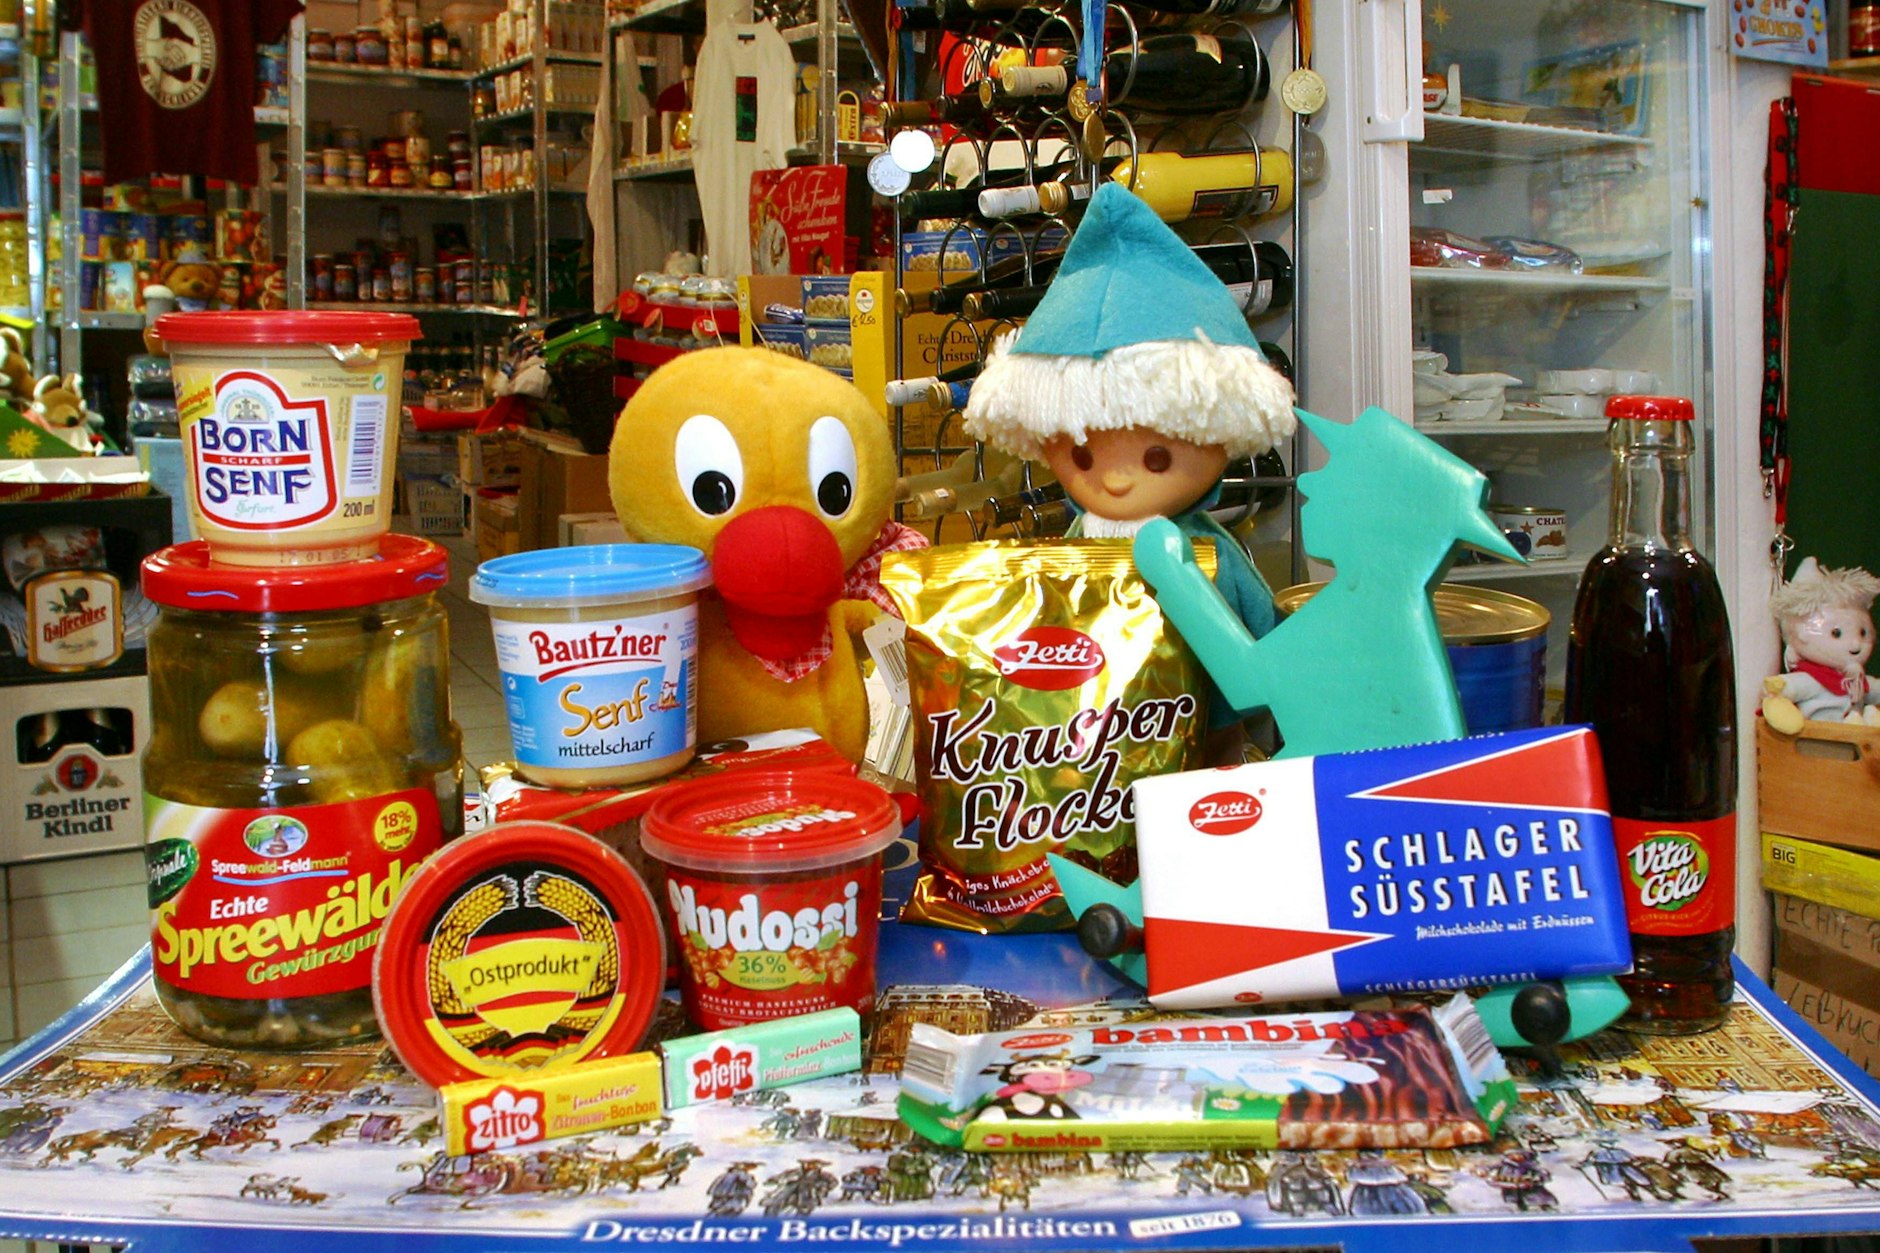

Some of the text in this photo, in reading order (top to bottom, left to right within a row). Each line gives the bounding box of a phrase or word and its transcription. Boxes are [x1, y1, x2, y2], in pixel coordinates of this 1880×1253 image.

[199, 417, 311, 454] BORN
[220, 456, 282, 465] SCHARF
[205, 466, 313, 504] SENF
[344, 499, 375, 517] 200 ml
[528, 625, 667, 666] Bautz'ner
[558, 678, 650, 738] Senf
[558, 731, 655, 757] mittelscharf
[930, 694, 1195, 783] Knusper
[25, 797, 131, 821] Berliner
[43, 814, 114, 838] Kindl
[384, 825, 410, 839] mehr
[1344, 816, 1583, 874] SCHLAGER
[1627, 839, 1696, 876] Vita
[1772, 847, 1796, 865] BIG
[211, 856, 348, 876] Spreewald-Feldmann
[1349, 863, 1591, 919] SÜSSTAFEL
[1640, 871, 1707, 907] Cola
[210, 896, 268, 920] Echte
[668, 879, 859, 951] Nudossi
[1507, 920, 1528, 931] mit
[1531, 914, 1595, 930] Erdnüssen
[739, 976, 786, 985] Haselnuss
[1090, 1020, 1410, 1044] bambina
[699, 1058, 748, 1089] pfeffi
[478, 1109, 531, 1138] zitro
[1012, 1133, 1102, 1148] bambina
[581, 1218, 767, 1243] Dresdner
[777, 1217, 1119, 1247] Backspezialitäten
[1139, 1220, 1176, 1234] seit
